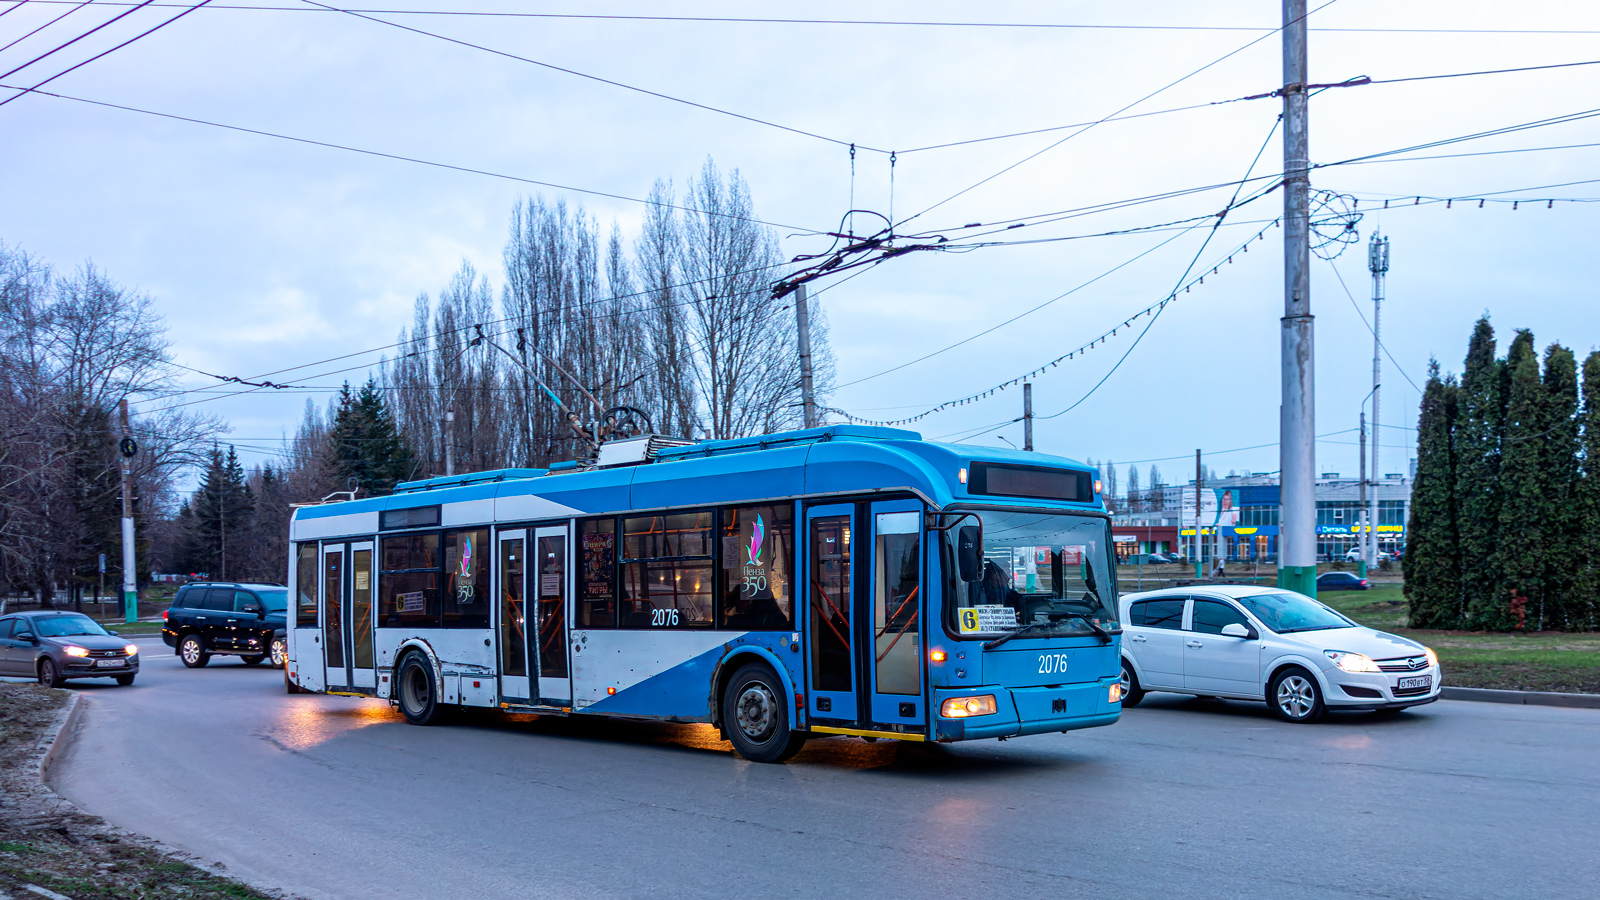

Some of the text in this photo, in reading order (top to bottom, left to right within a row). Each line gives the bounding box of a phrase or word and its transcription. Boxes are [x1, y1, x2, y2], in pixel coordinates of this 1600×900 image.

[743, 566, 765, 576] Пенза
[457, 585, 473, 602] 350
[742, 576, 766, 597] 350
[398, 597, 403, 609] 6
[651, 609, 679, 626] 2076
[963, 611, 976, 629] 6
[1038, 654, 1067, 673] 2076
